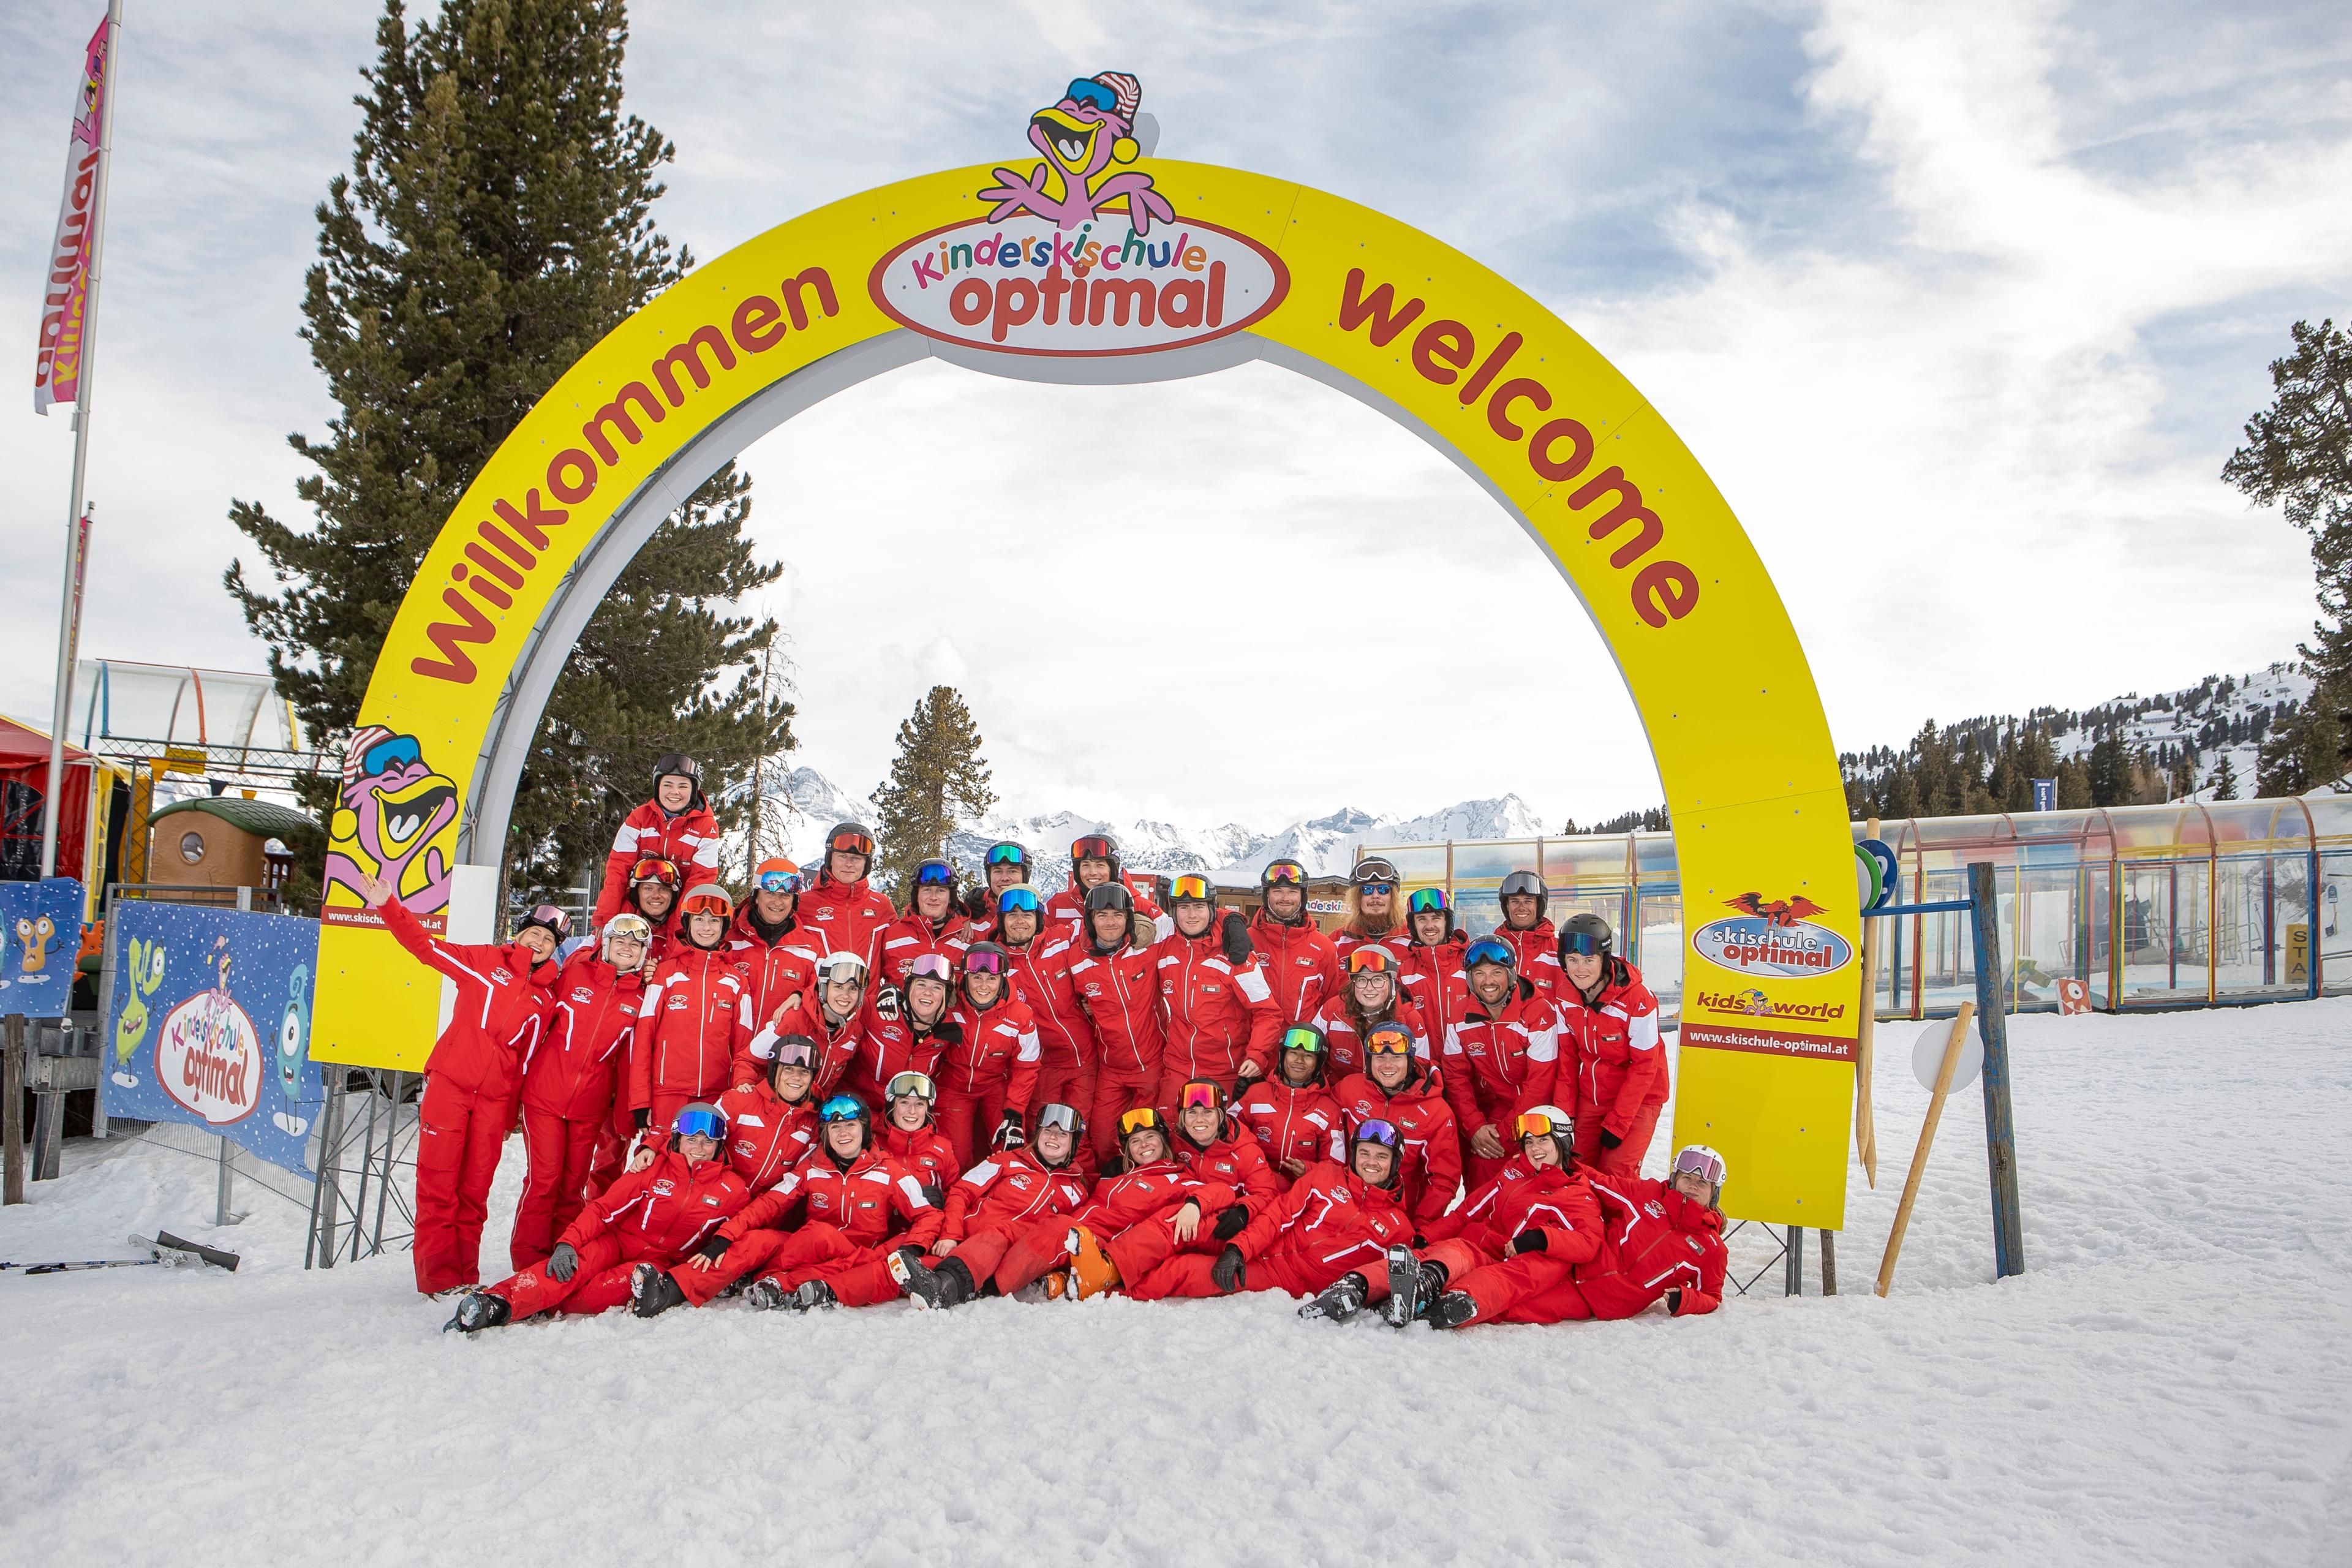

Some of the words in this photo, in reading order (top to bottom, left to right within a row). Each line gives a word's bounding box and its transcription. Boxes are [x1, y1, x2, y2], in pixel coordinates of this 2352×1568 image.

[911, 224, 1207, 289] Kinderskischule
[949, 260, 1226, 342] optimal
[410, 267, 840, 684] Willkommen
[1339, 268, 1700, 628] welcome
[1713, 926, 1818, 950] skischule
[1723, 941, 1833, 968] optimal
[1697, 992, 1746, 1010] kids
[1774, 1003, 1845, 1019] world
[184, 1041, 248, 1107] optimal
[1690, 1031, 1848, 1055] www.skischule-optimal.at
